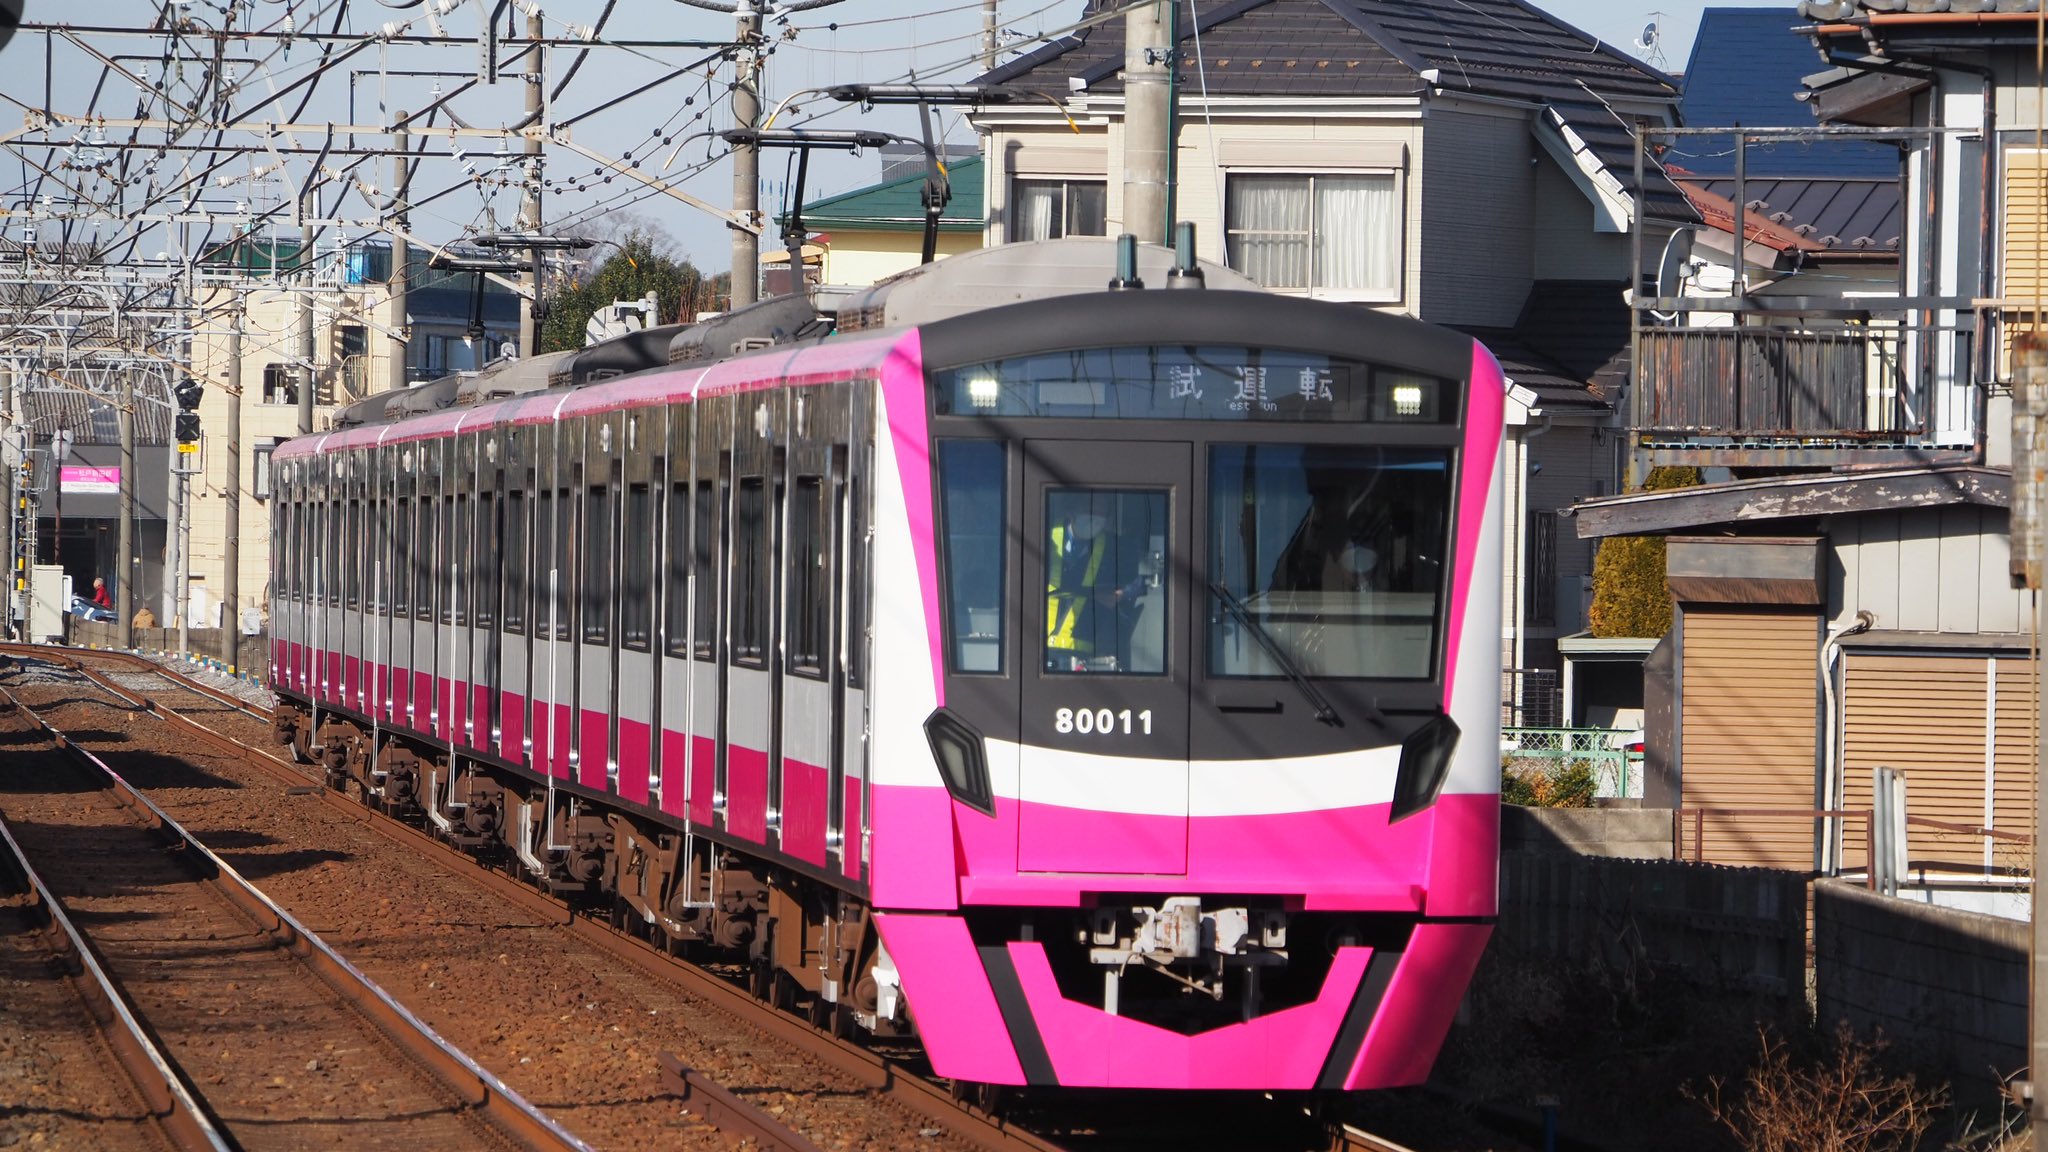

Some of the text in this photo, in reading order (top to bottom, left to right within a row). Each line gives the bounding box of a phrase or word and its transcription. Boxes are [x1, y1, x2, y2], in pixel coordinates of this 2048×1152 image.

[1169, 365, 1334, 401] 試運転
[1258, 400, 1278, 411] un
[1055, 707, 1153, 735] 80011
